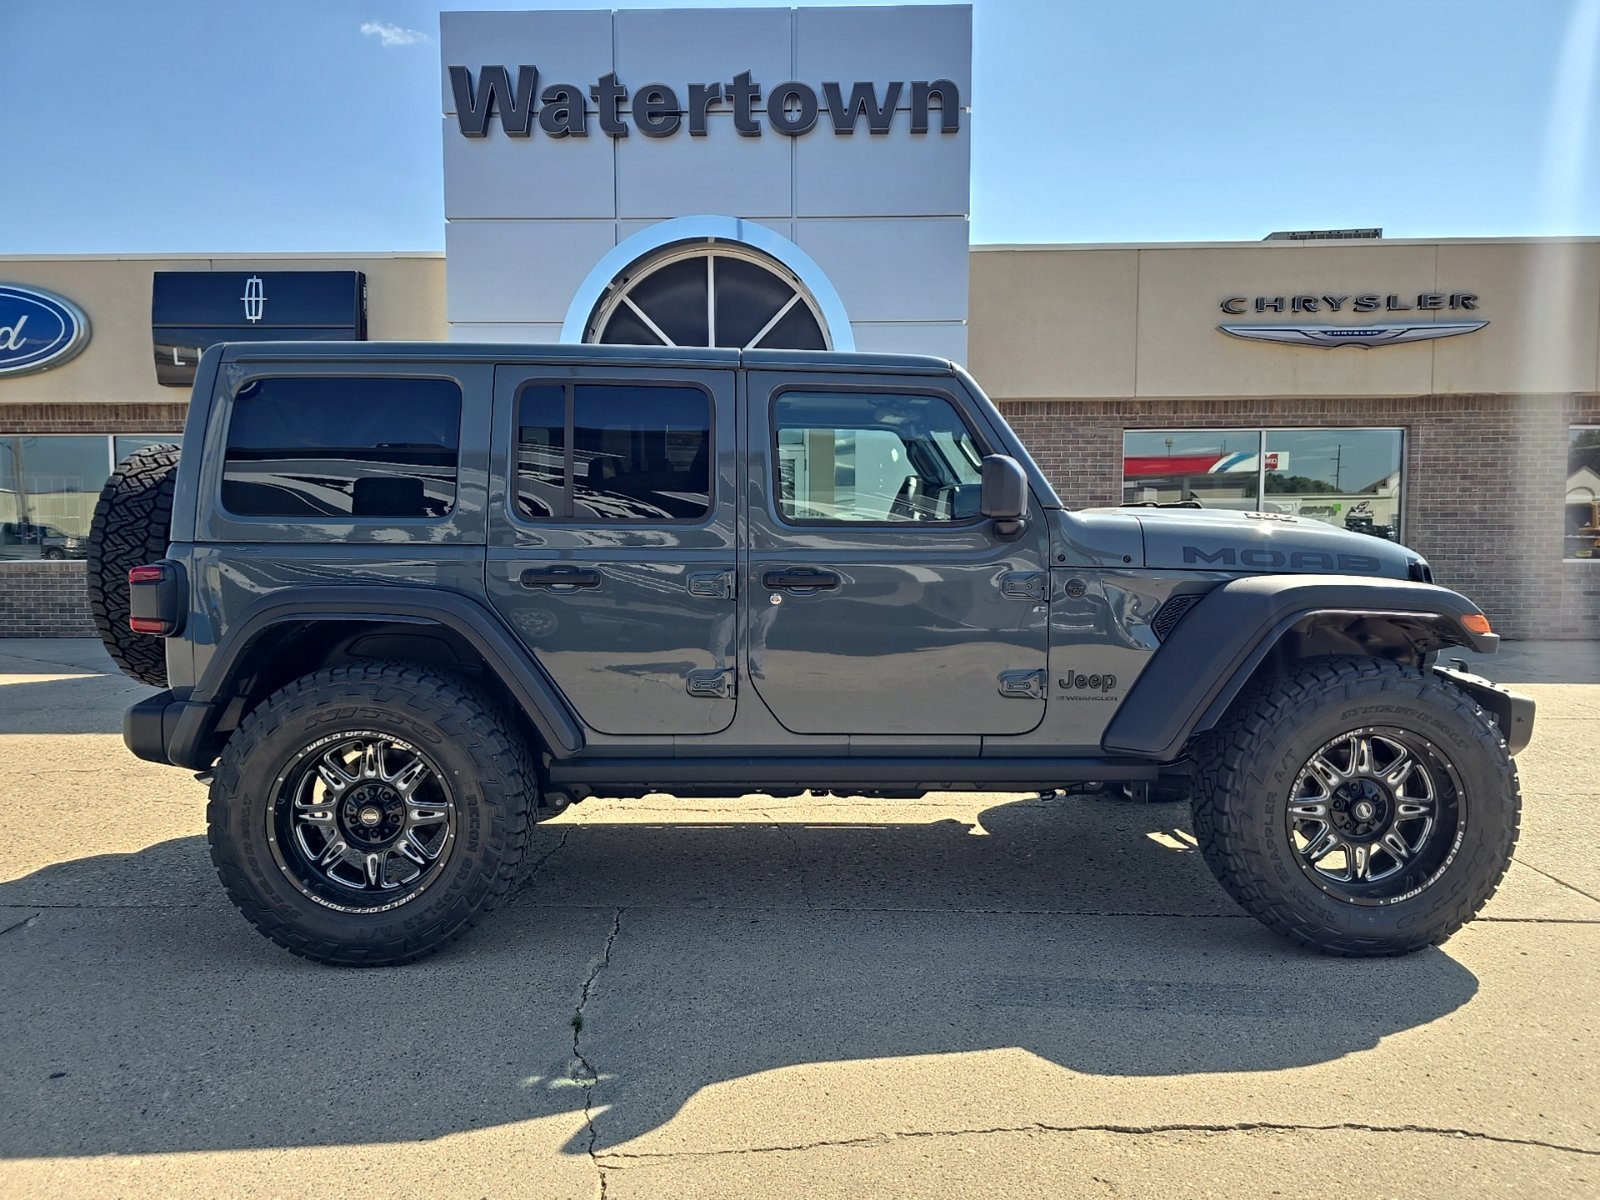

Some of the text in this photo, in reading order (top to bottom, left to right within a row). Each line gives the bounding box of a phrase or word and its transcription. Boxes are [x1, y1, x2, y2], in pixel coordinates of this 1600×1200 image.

[447, 65, 960, 138] Watertown
[1220, 293, 1480, 314] CHRYSLER
[1182, 546, 1381, 572] MOAB
[1058, 669, 1117, 693] Jeep
[303, 706, 442, 743] NITTO
[306, 730, 413, 752] WELD OFF-ROAD
[1288, 767, 1307, 801] WELD
[465, 794, 480, 853] RECON
[1445, 830, 1464, 865] WELD
[381, 892, 417, 912] WELD
